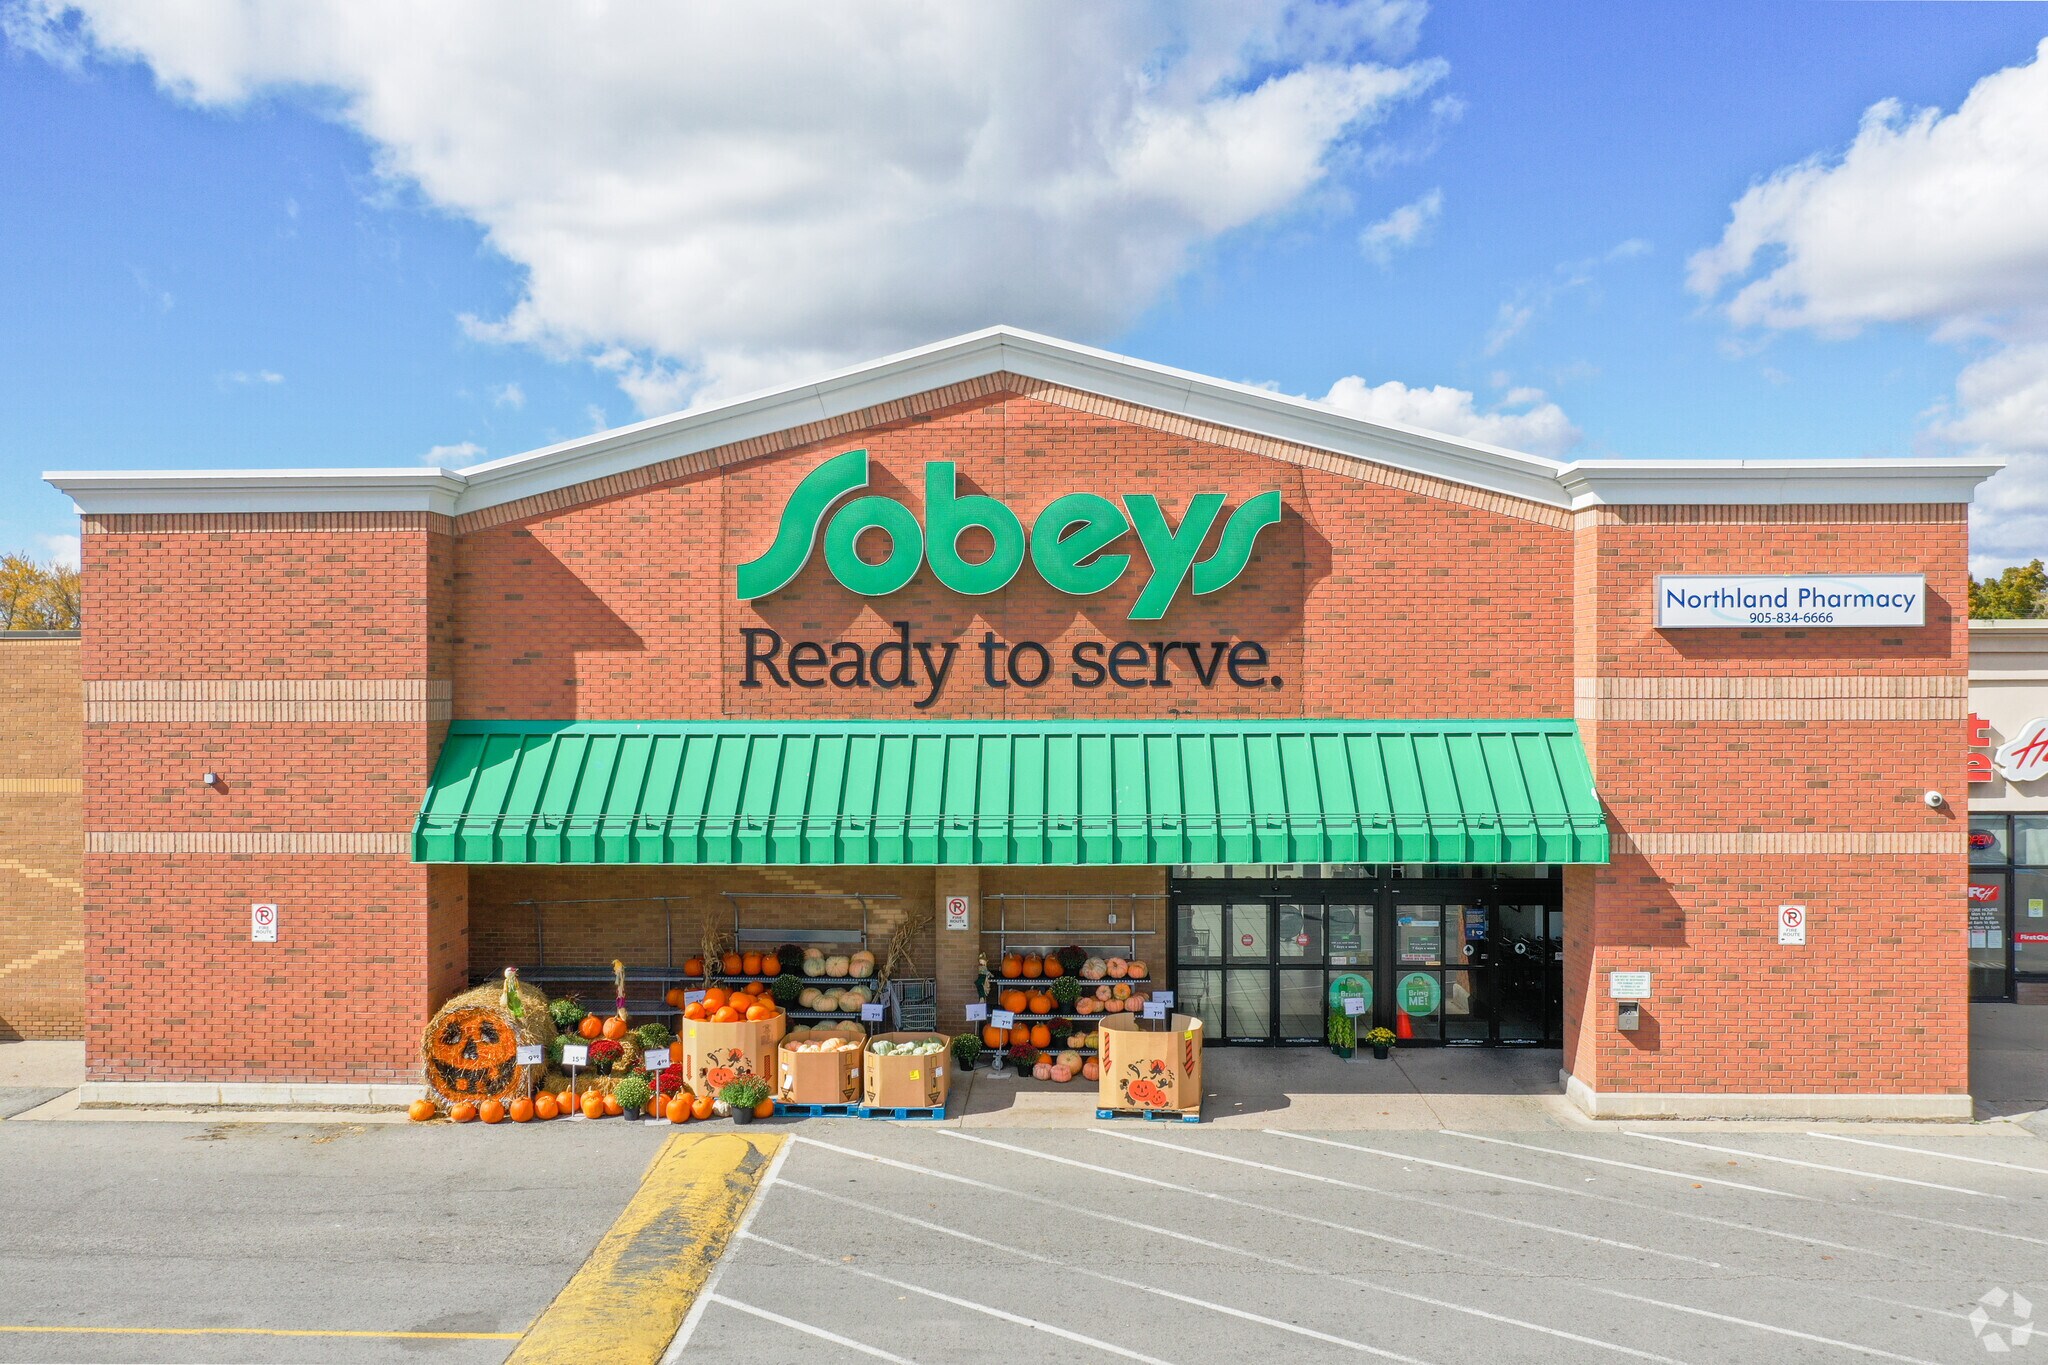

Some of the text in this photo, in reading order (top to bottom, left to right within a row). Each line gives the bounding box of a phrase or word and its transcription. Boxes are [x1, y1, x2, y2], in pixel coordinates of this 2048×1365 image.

[737, 448, 1282, 620] Sobeys
[1666, 587, 1916, 613] Northland Pharmacy
[1749, 612, 1834, 624] 905-834-6666
[739, 621, 1284, 709] Ready to serve.
[1408, 989, 1429, 998] Bring
[1408, 997, 1428, 1006] ME!
